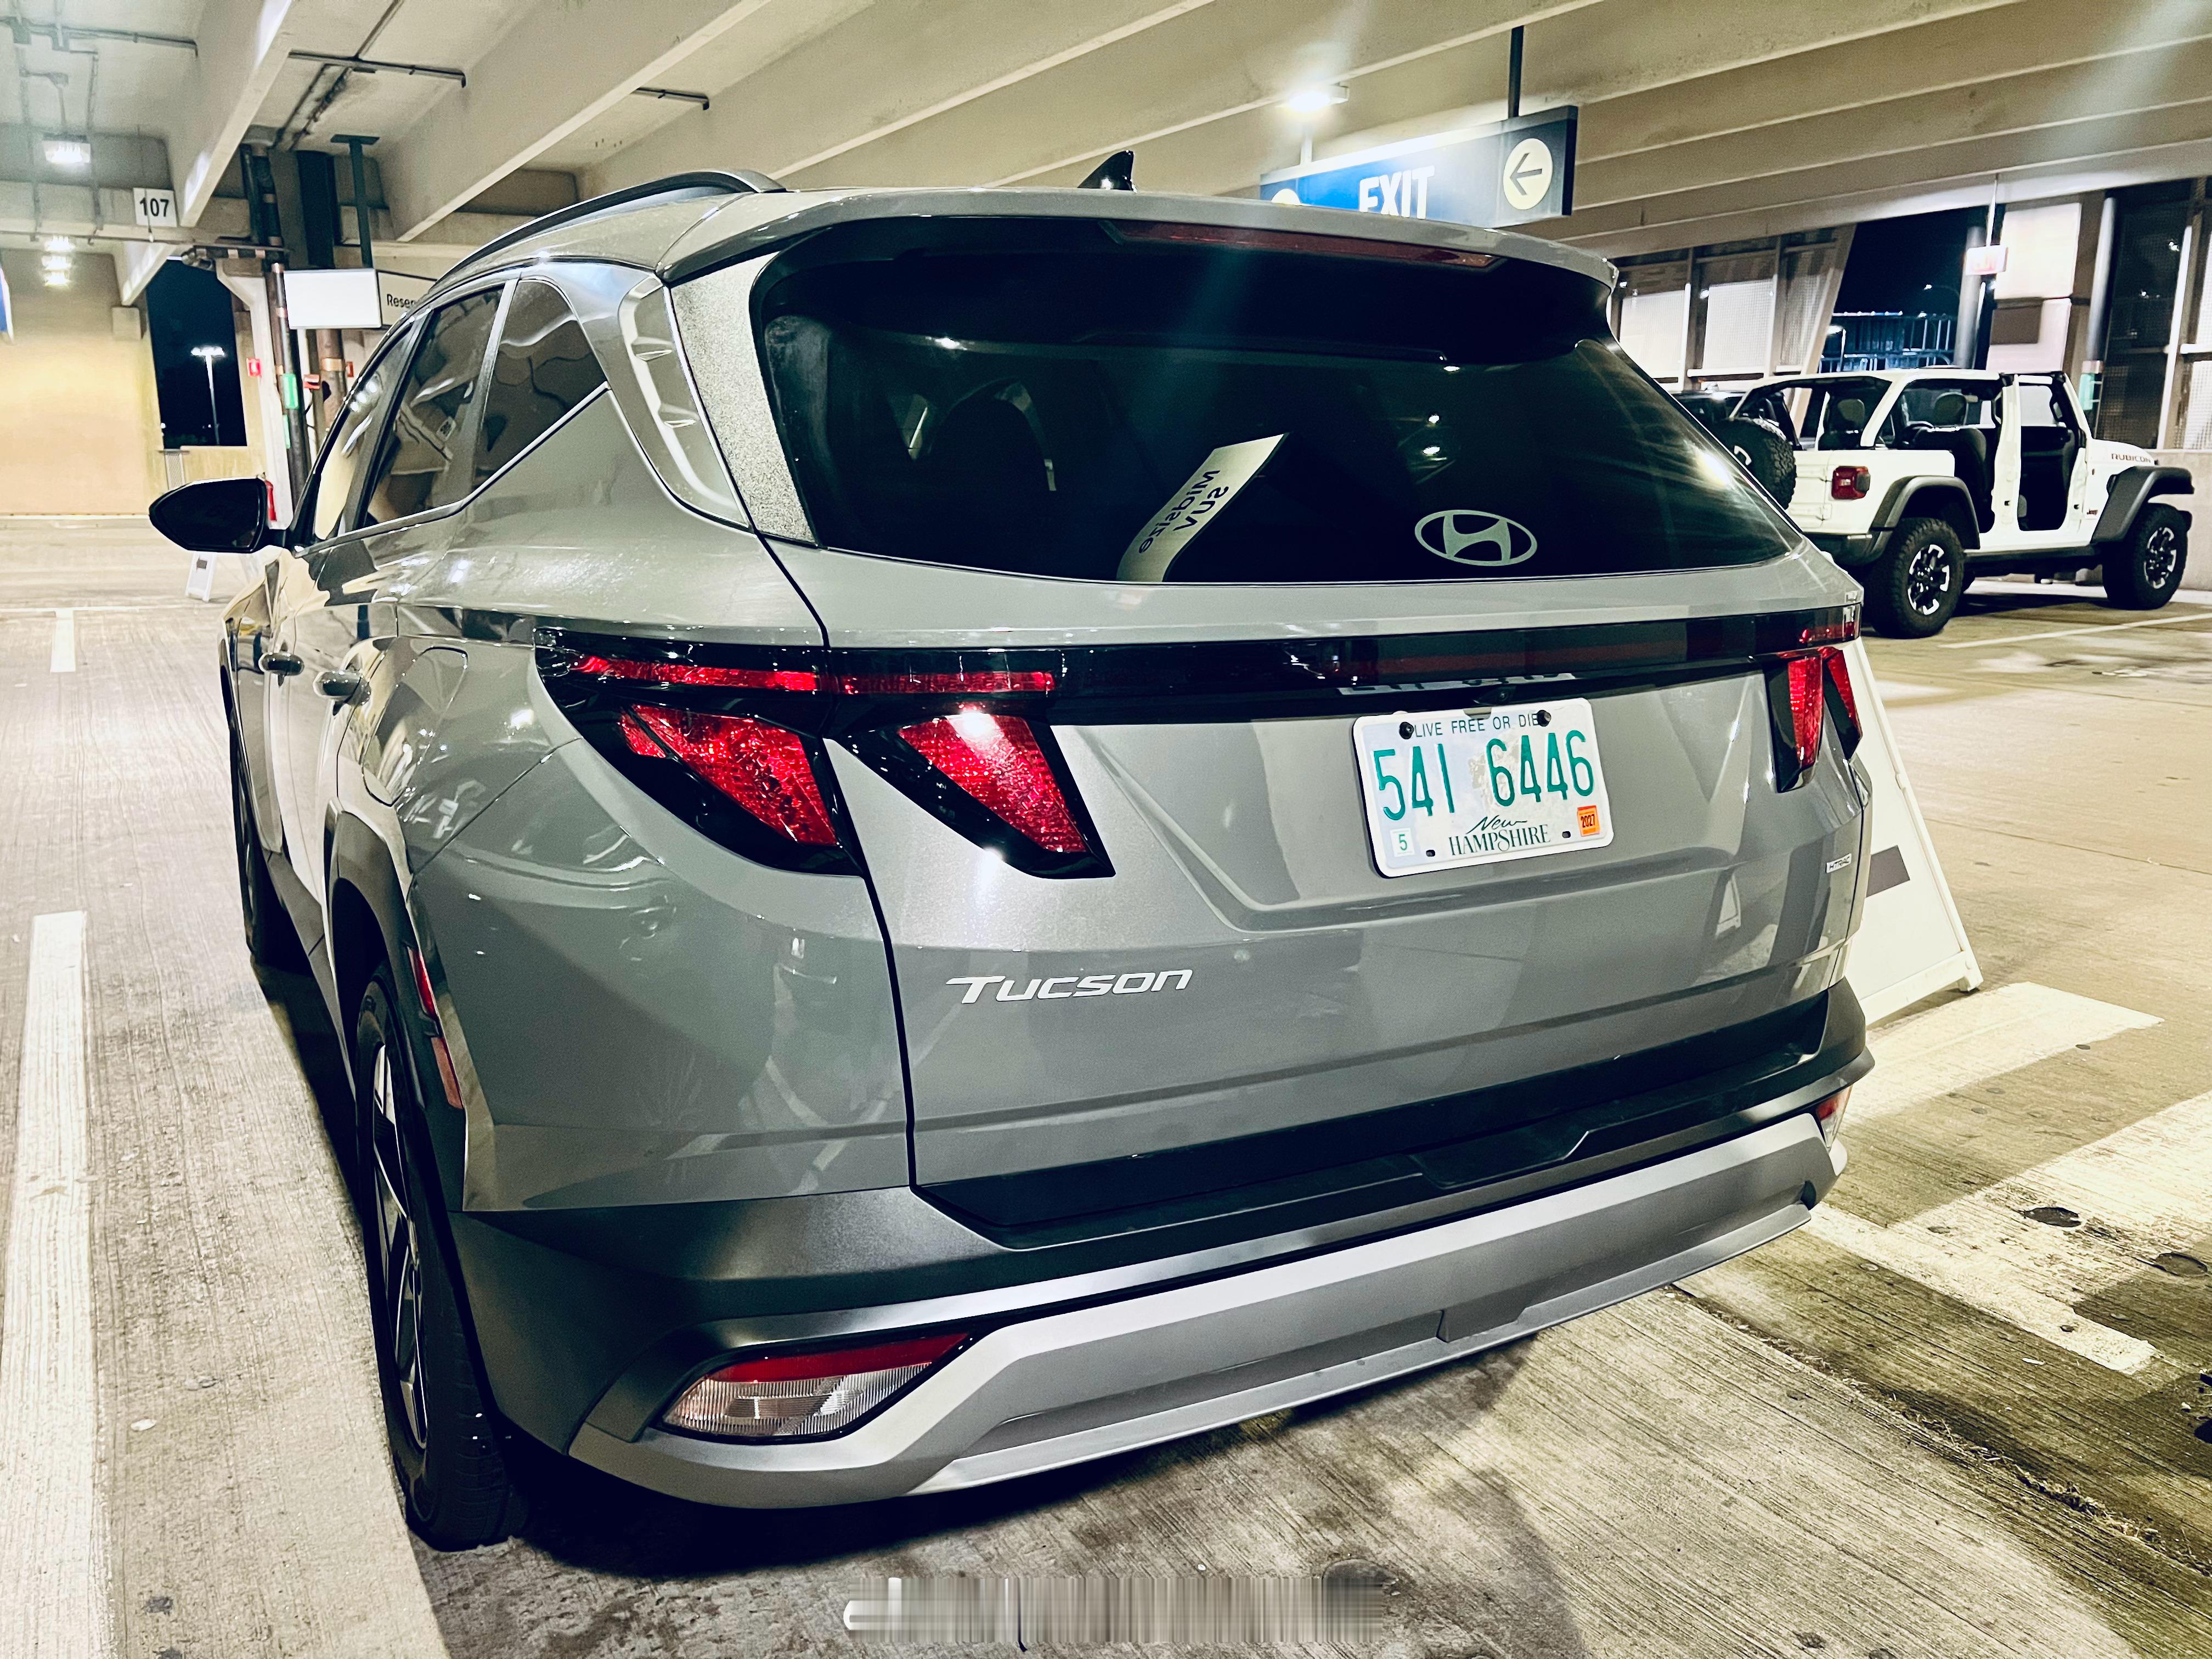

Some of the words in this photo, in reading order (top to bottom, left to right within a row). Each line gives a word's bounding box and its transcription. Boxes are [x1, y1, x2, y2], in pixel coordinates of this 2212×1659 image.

[1359, 166, 1435, 219] EXIT
[139, 198, 169, 217] 107
[387, 294, 416, 308] Reser
[2111, 453, 2151, 463] RUBICON
[1413, 722, 1443, 738] LIVE
[1451, 718, 1485, 734] FREE
[1493, 716, 1511, 730] OR
[1519, 714, 1539, 727] DIE
[1373, 743, 1455, 821] 541
[1486, 730, 1594, 807] 6446
[1465, 815, 1528, 834] New
[1581, 814, 1595, 828] 2027
[1398, 833, 1408, 851] 5
[1448, 823, 1551, 856] HAMPSHIRE
[945, 969, 1193, 1005] TUCSON
